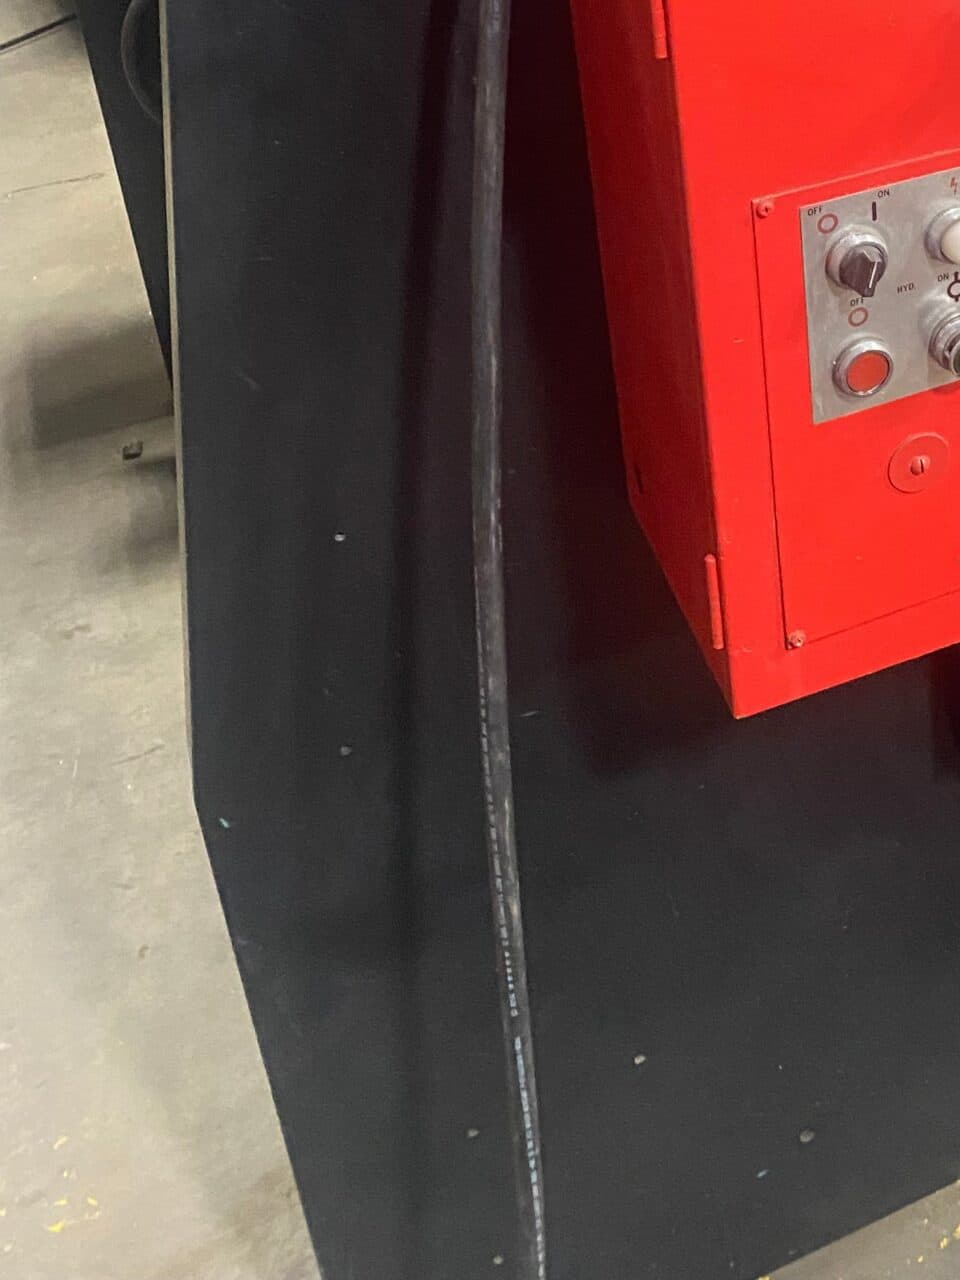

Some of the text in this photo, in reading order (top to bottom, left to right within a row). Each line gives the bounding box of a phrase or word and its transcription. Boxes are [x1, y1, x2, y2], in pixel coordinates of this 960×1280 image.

[877, 188, 890, 198] ON
[807, 206, 823, 217] OFF
[937, 272, 950, 282] ON
